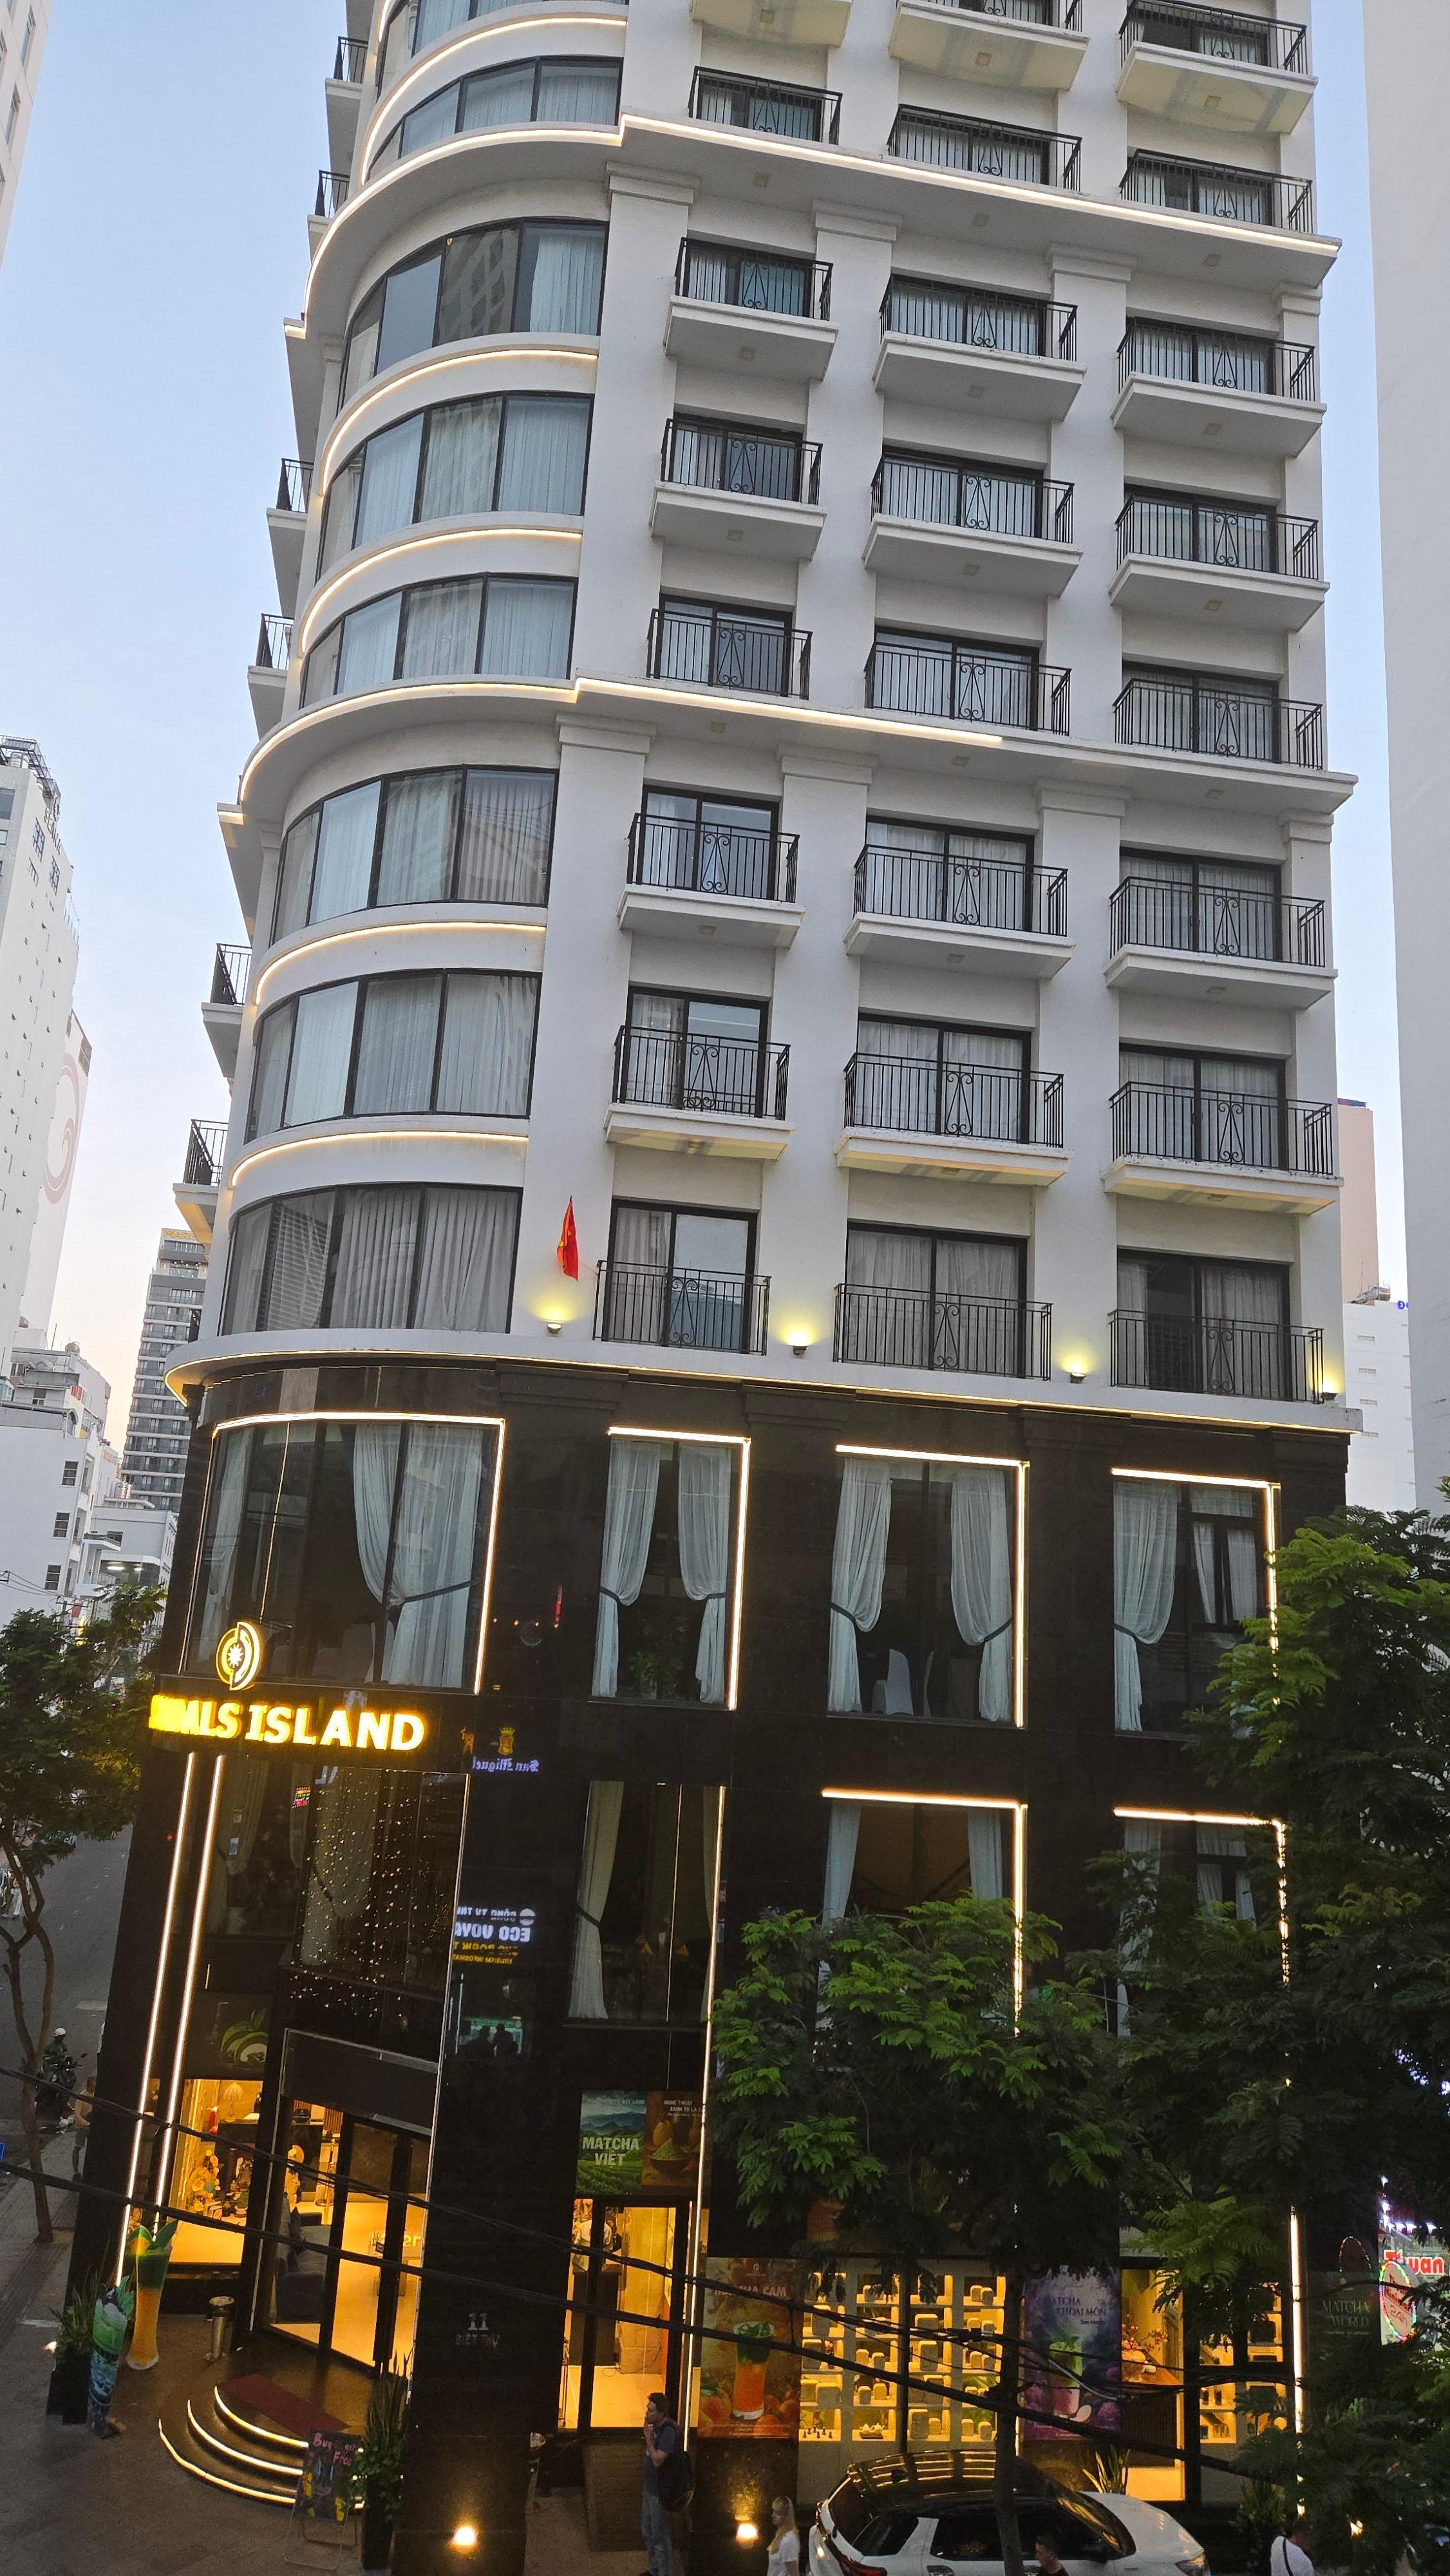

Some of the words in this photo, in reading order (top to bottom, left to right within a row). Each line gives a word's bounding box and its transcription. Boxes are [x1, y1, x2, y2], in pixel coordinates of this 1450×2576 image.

[245, 1704, 426, 1751] ISLAND
[583, 2137, 639, 2151] MATCHA
[594, 2151, 626, 2168] VIỆT
[468, 2313, 489, 2330] 11
[314, 2432, 333, 2452] Buy
